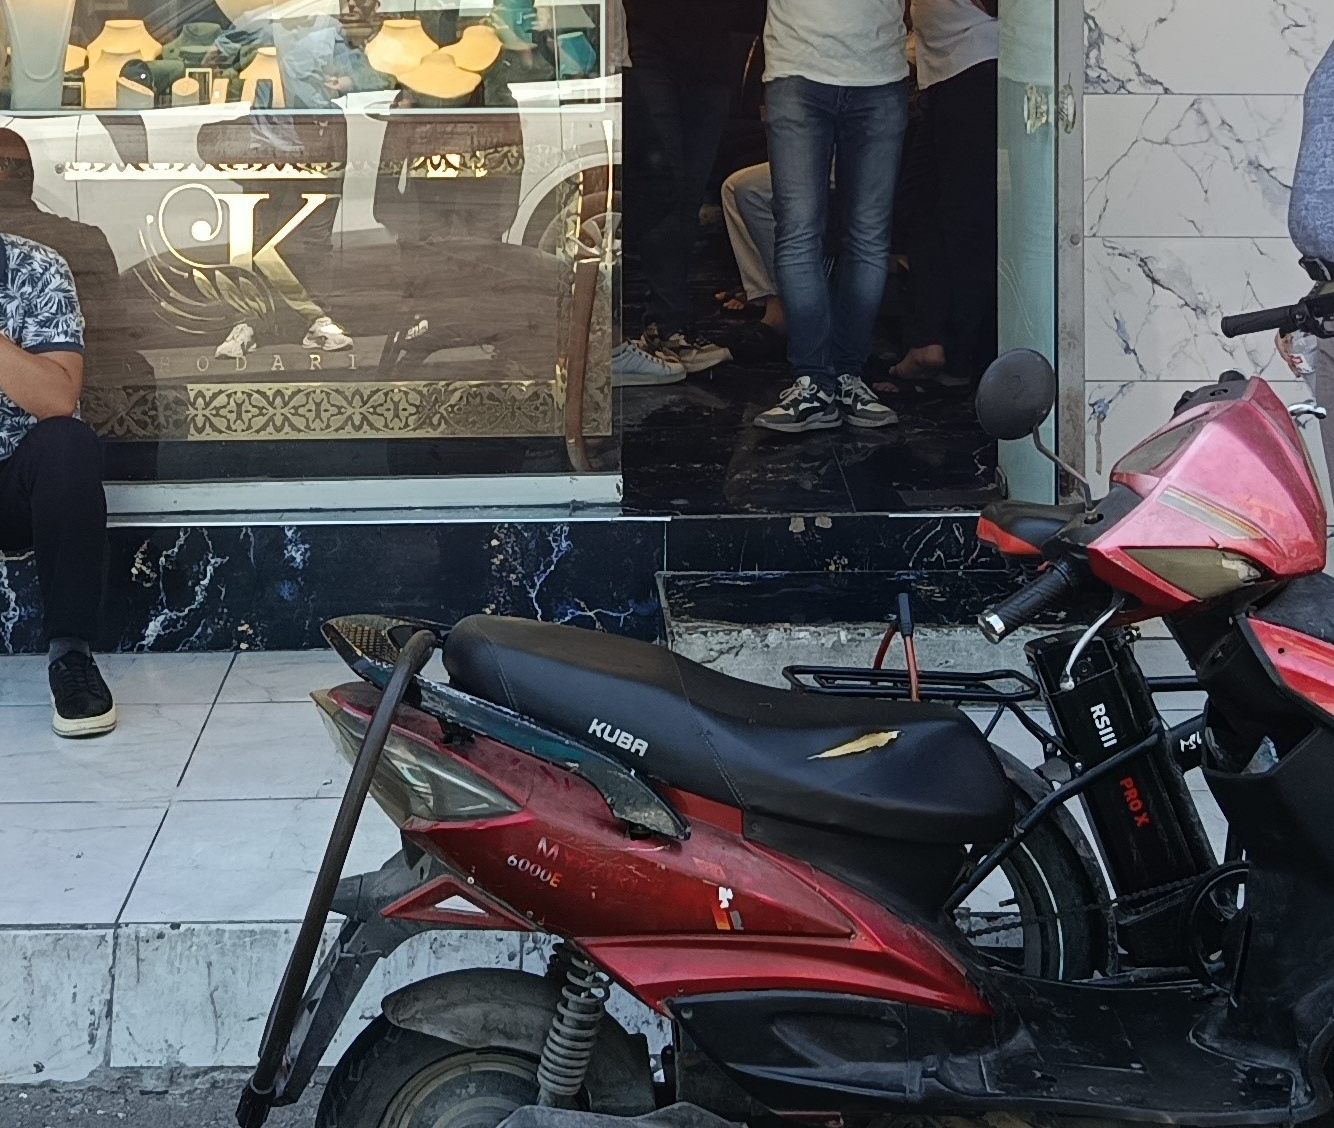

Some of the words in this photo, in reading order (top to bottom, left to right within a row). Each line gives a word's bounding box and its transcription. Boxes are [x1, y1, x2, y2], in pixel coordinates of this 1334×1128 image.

[588, 718, 649, 757] KUBA
[1090, 702, 1118, 748] RSIII
[1120, 775, 1144, 813] PRO
[1133, 811, 1150, 828] X
[507, 854, 564, 889] 6000E
